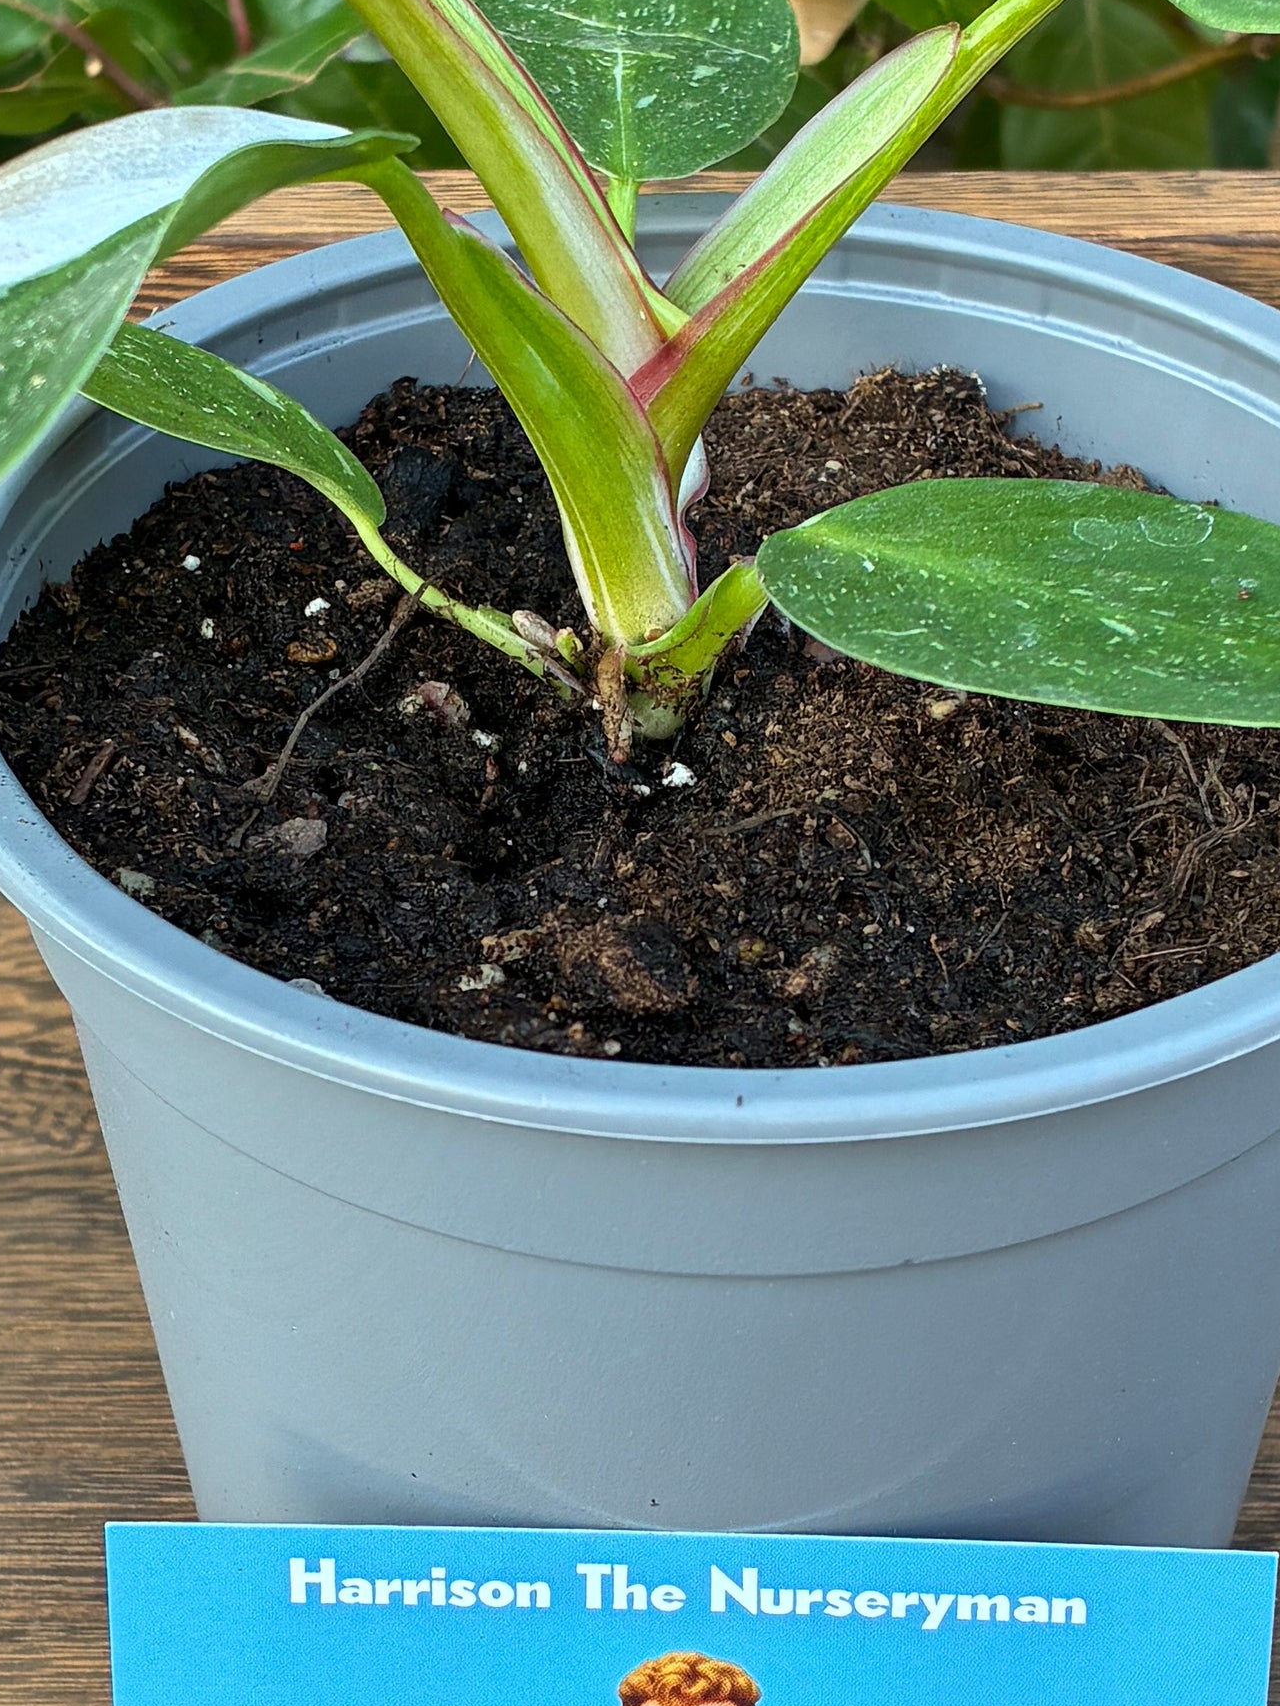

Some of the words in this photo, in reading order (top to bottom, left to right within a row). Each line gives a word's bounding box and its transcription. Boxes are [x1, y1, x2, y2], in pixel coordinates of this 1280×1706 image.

[288, 1557, 552, 1608] Harrison
[575, 1562, 686, 1613] The
[709, 1565, 1088, 1631] Nurseryman
